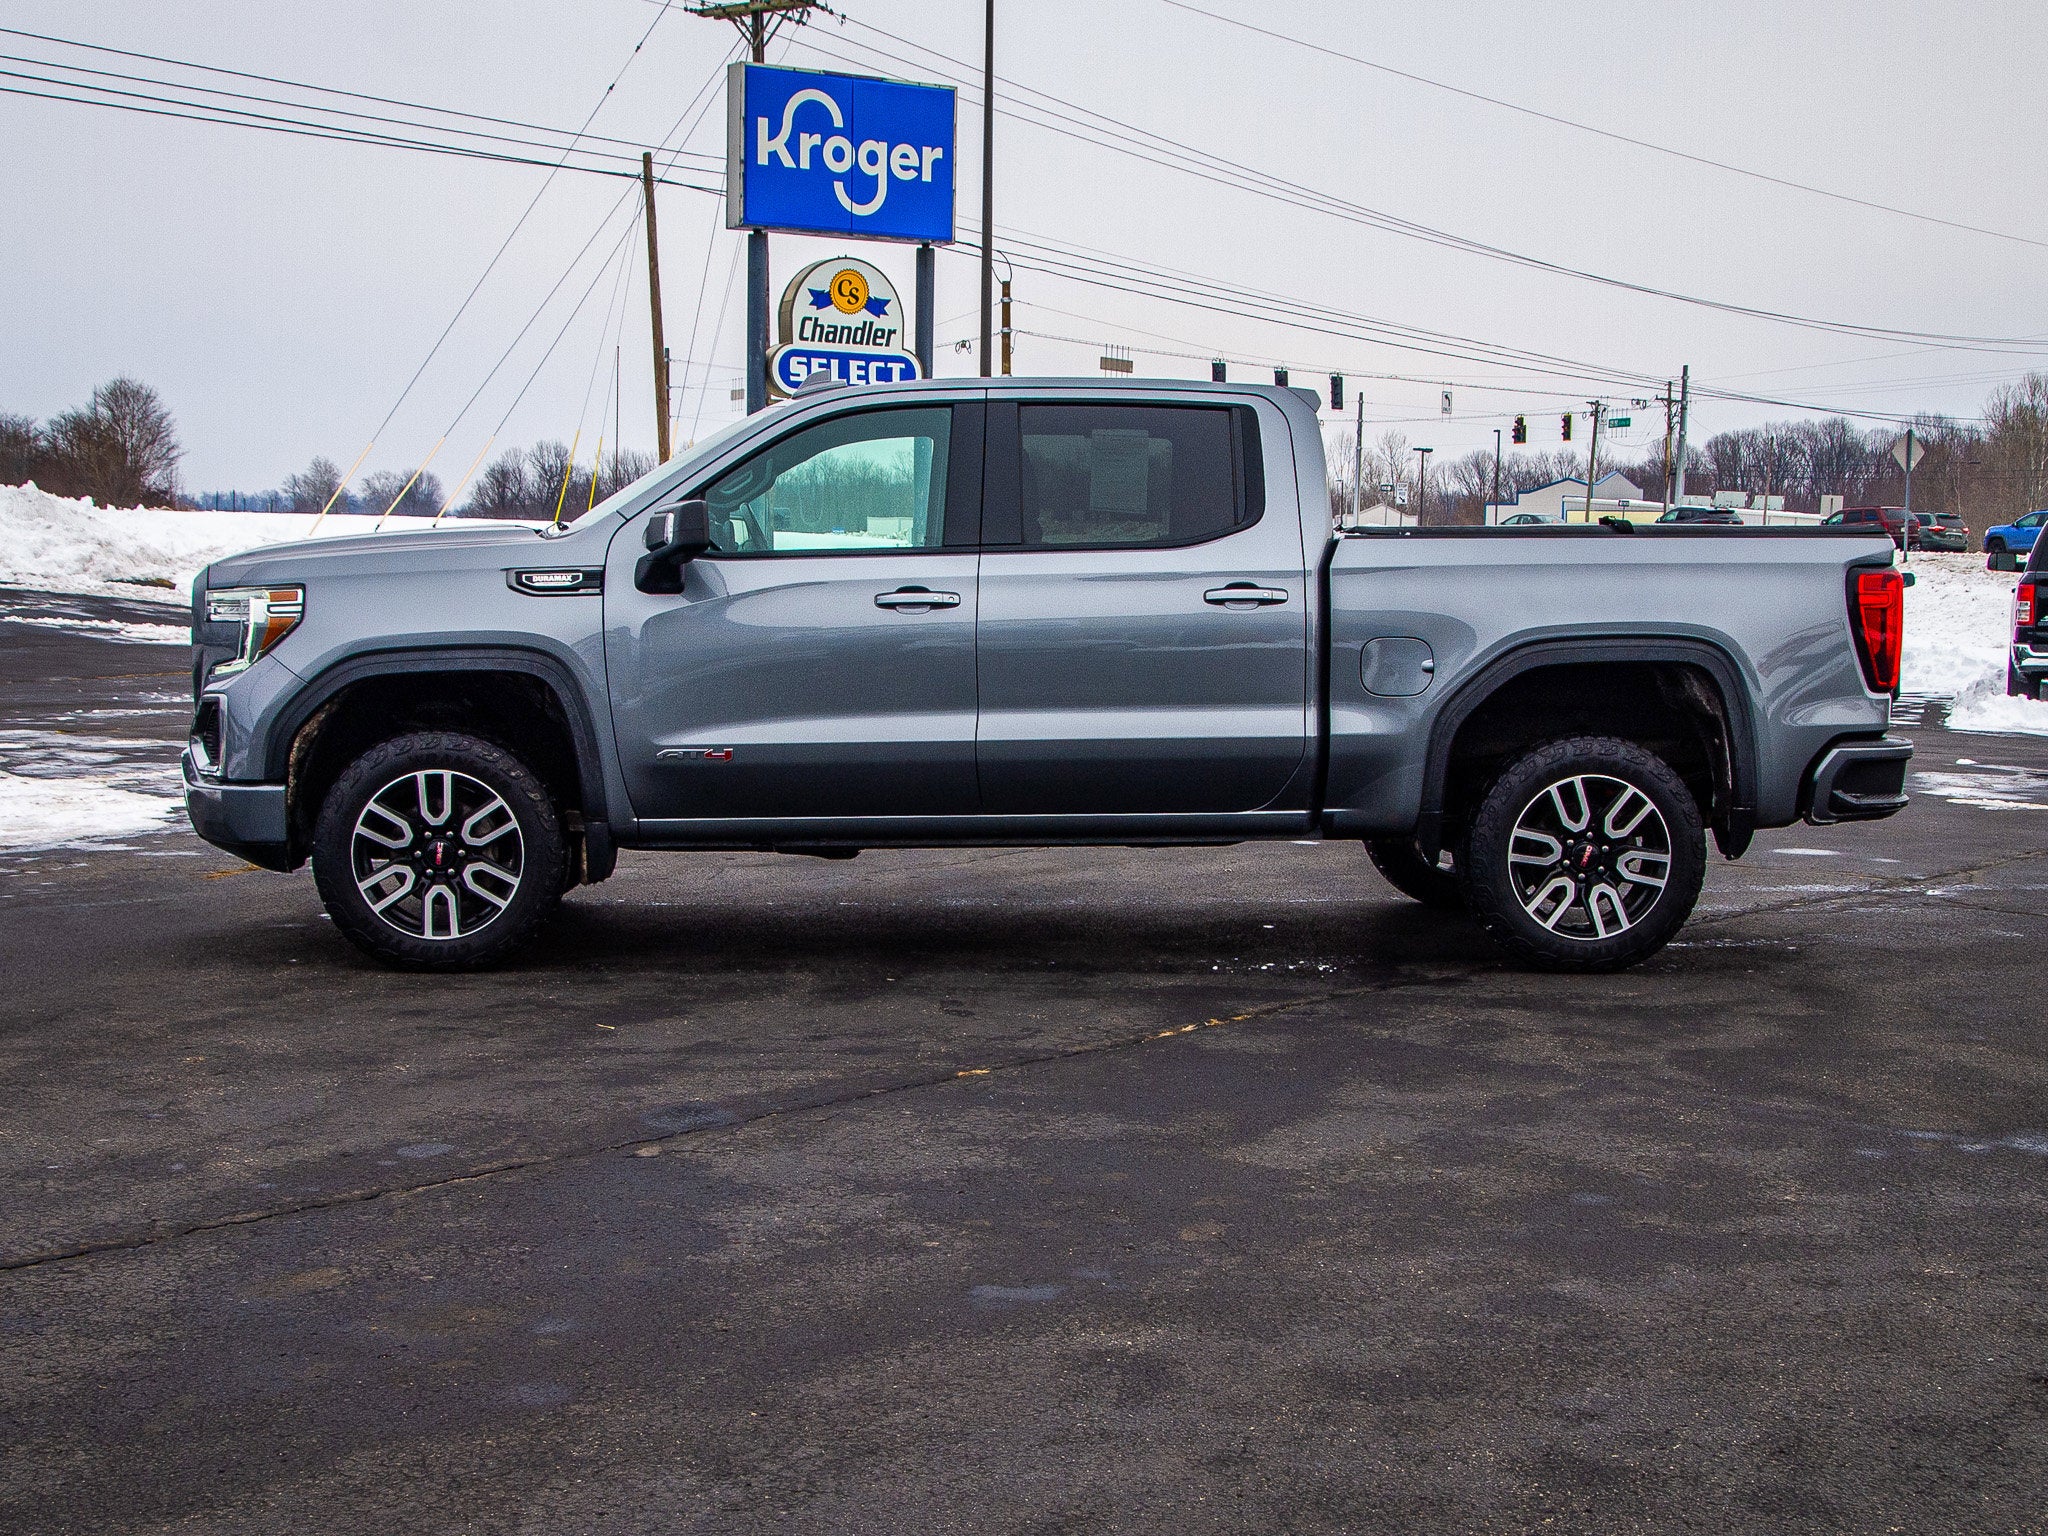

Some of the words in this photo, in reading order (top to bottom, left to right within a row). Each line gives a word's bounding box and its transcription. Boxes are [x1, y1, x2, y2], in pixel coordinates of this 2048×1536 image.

[757, 88, 943, 217] Kroger
[837, 279, 860, 306] CS
[799, 316, 897, 347] Chandler
[532, 574, 573, 582] DURAMAX
